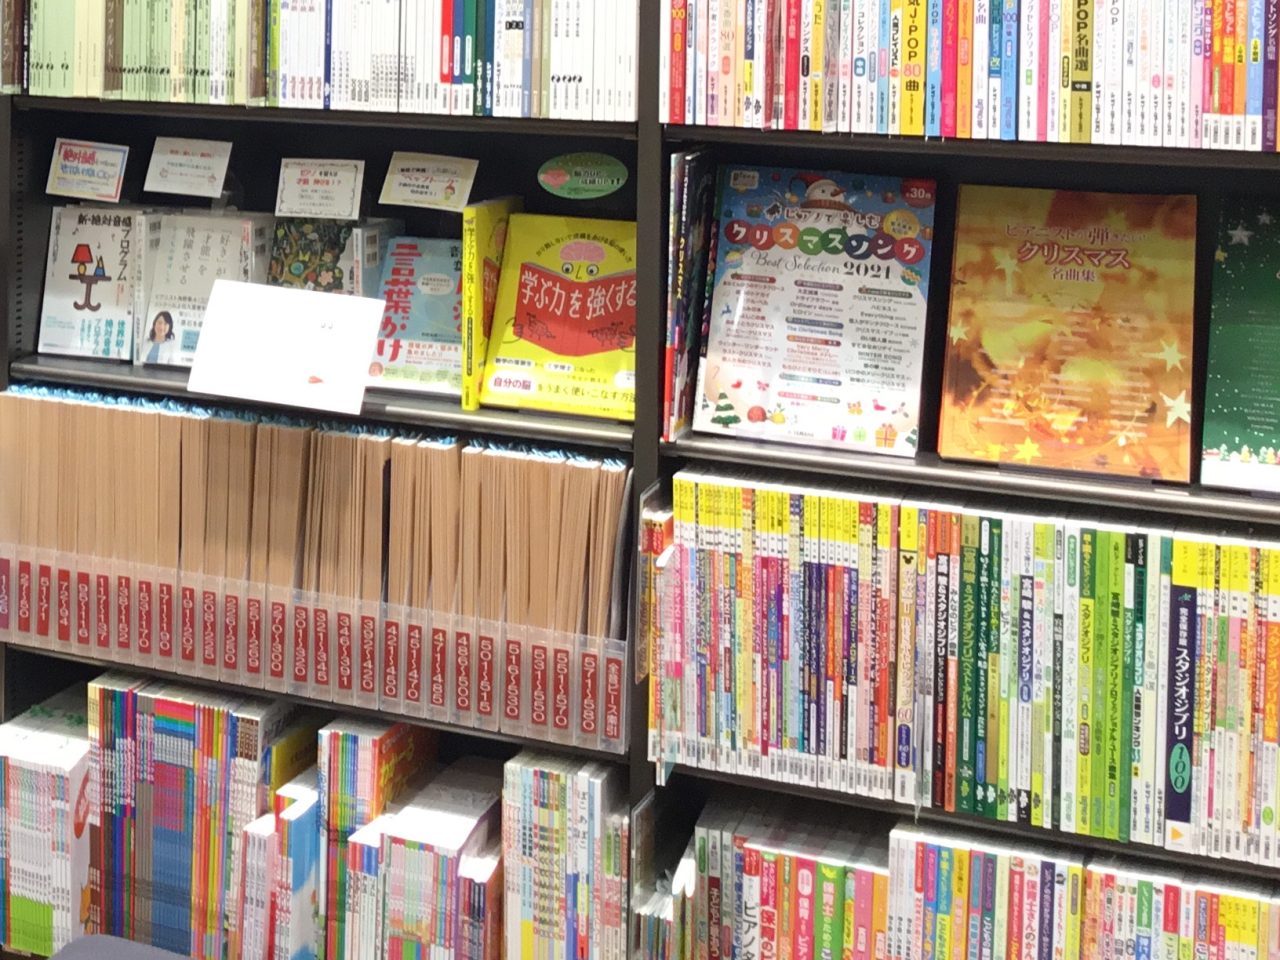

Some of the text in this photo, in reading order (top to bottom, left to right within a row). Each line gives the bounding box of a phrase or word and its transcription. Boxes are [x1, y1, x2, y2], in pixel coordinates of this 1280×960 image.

[116, 228, 131, 282] プログラム
[730, 222, 921, 261] クリスマスソング
[1016, 240, 1132, 269] クリスマス
[750, 250, 892, 281] Best Selection 2021
[376, 242, 422, 364] 言葉がけ
[520, 268, 637, 322] 学ぶ力を強くする
[492, 376, 532, 392] 自分の脳
[1173, 647, 1190, 741] スタジオジブリ
[1173, 746, 1189, 792] 100
